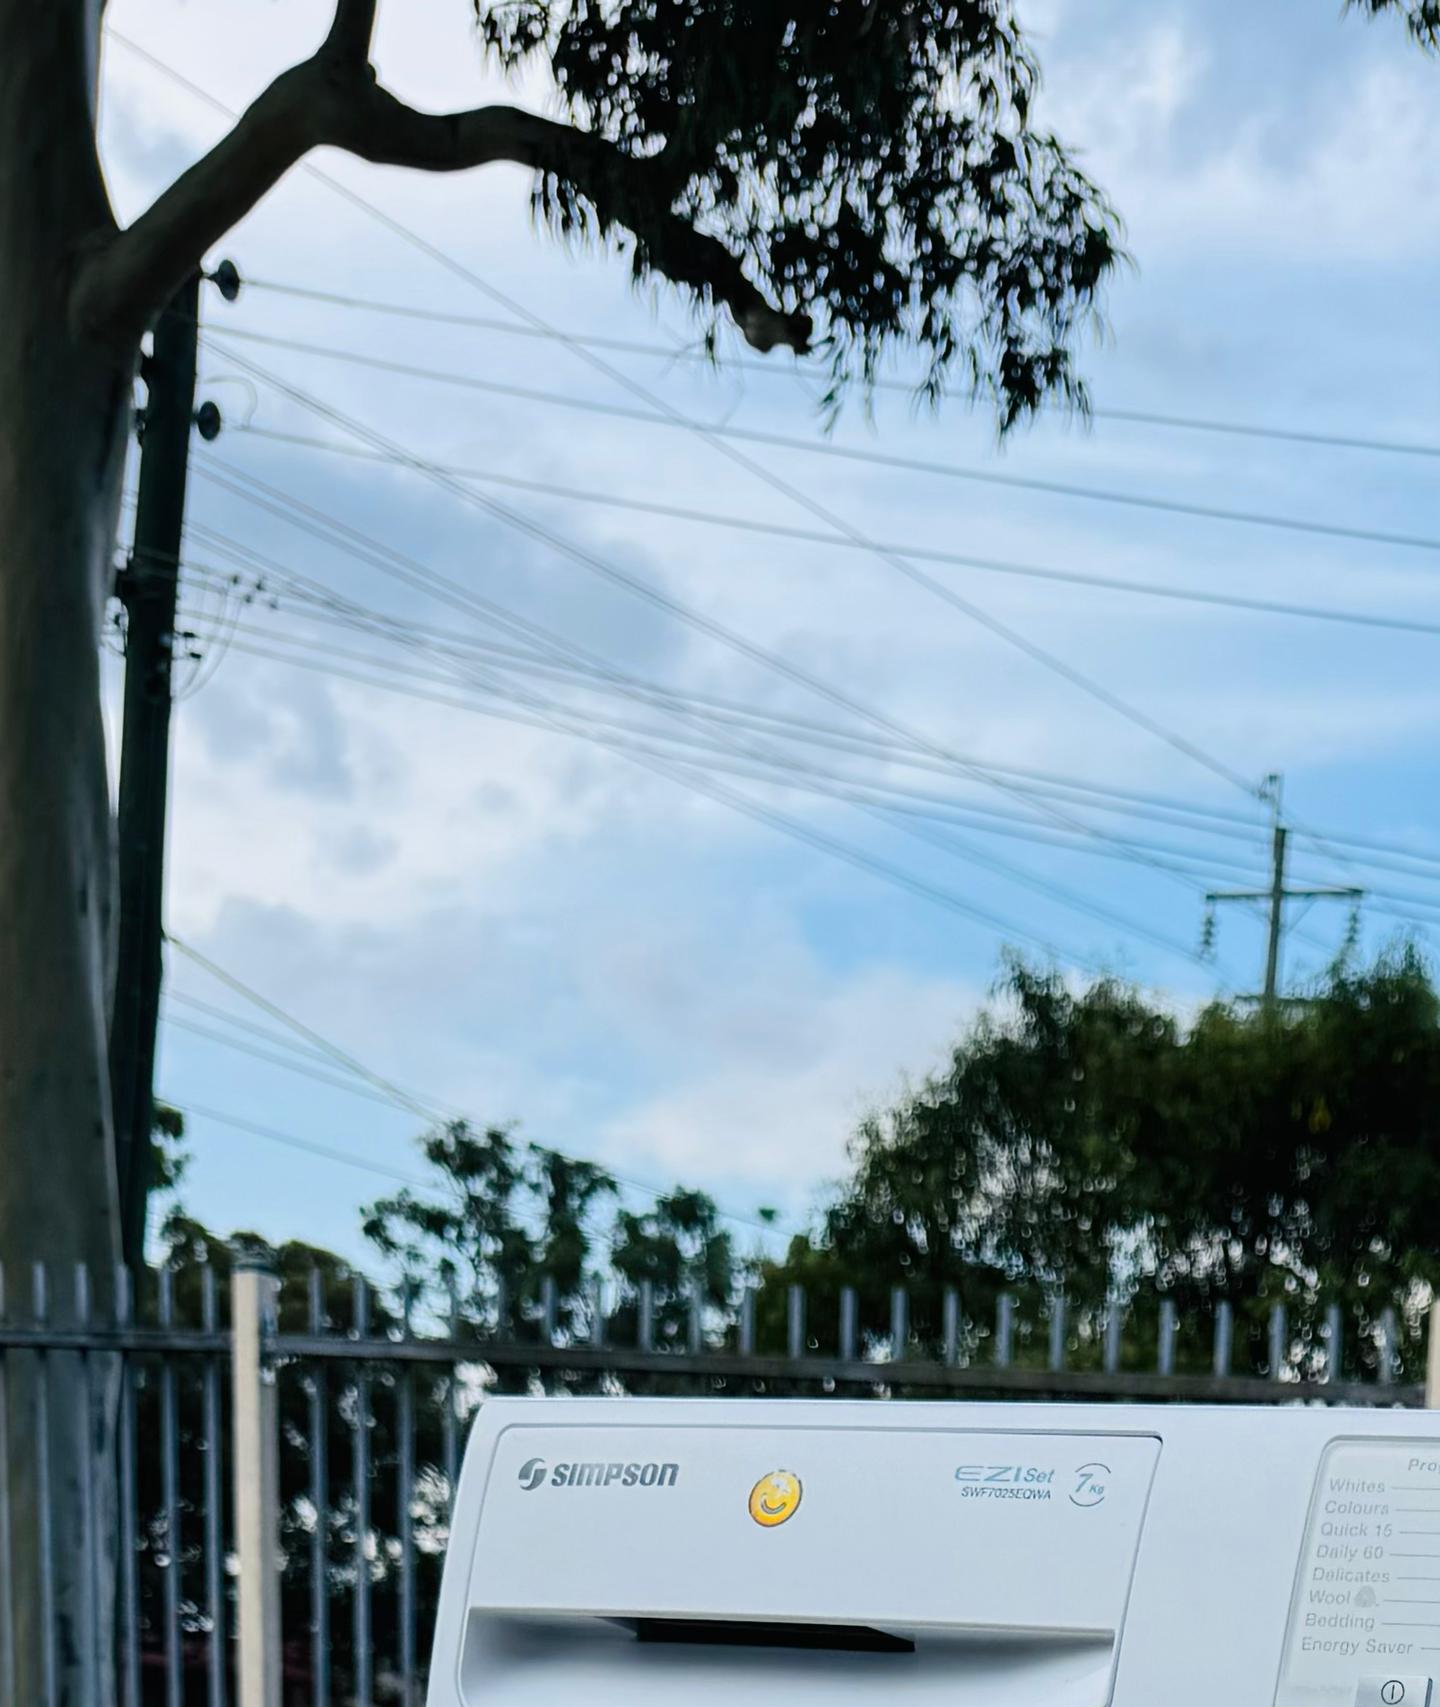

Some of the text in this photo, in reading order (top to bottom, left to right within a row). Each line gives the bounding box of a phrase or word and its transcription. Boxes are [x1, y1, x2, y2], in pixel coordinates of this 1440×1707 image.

[551, 1462, 680, 1487] SIMPSON
[1075, 1472, 1094, 1493] 7
[1329, 1478, 1386, 1493] Whites
[1324, 1500, 1390, 1515] Colours
[1320, 1522, 1368, 1537] Quick
[1316, 1544, 1384, 1562] Daily 60
[1312, 1566, 1391, 1583] Delicates
[1308, 1589, 1351, 1605] Wool
[1304, 1612, 1376, 1633] Bedding
[1301, 1636, 1414, 1656] Energy Saver
